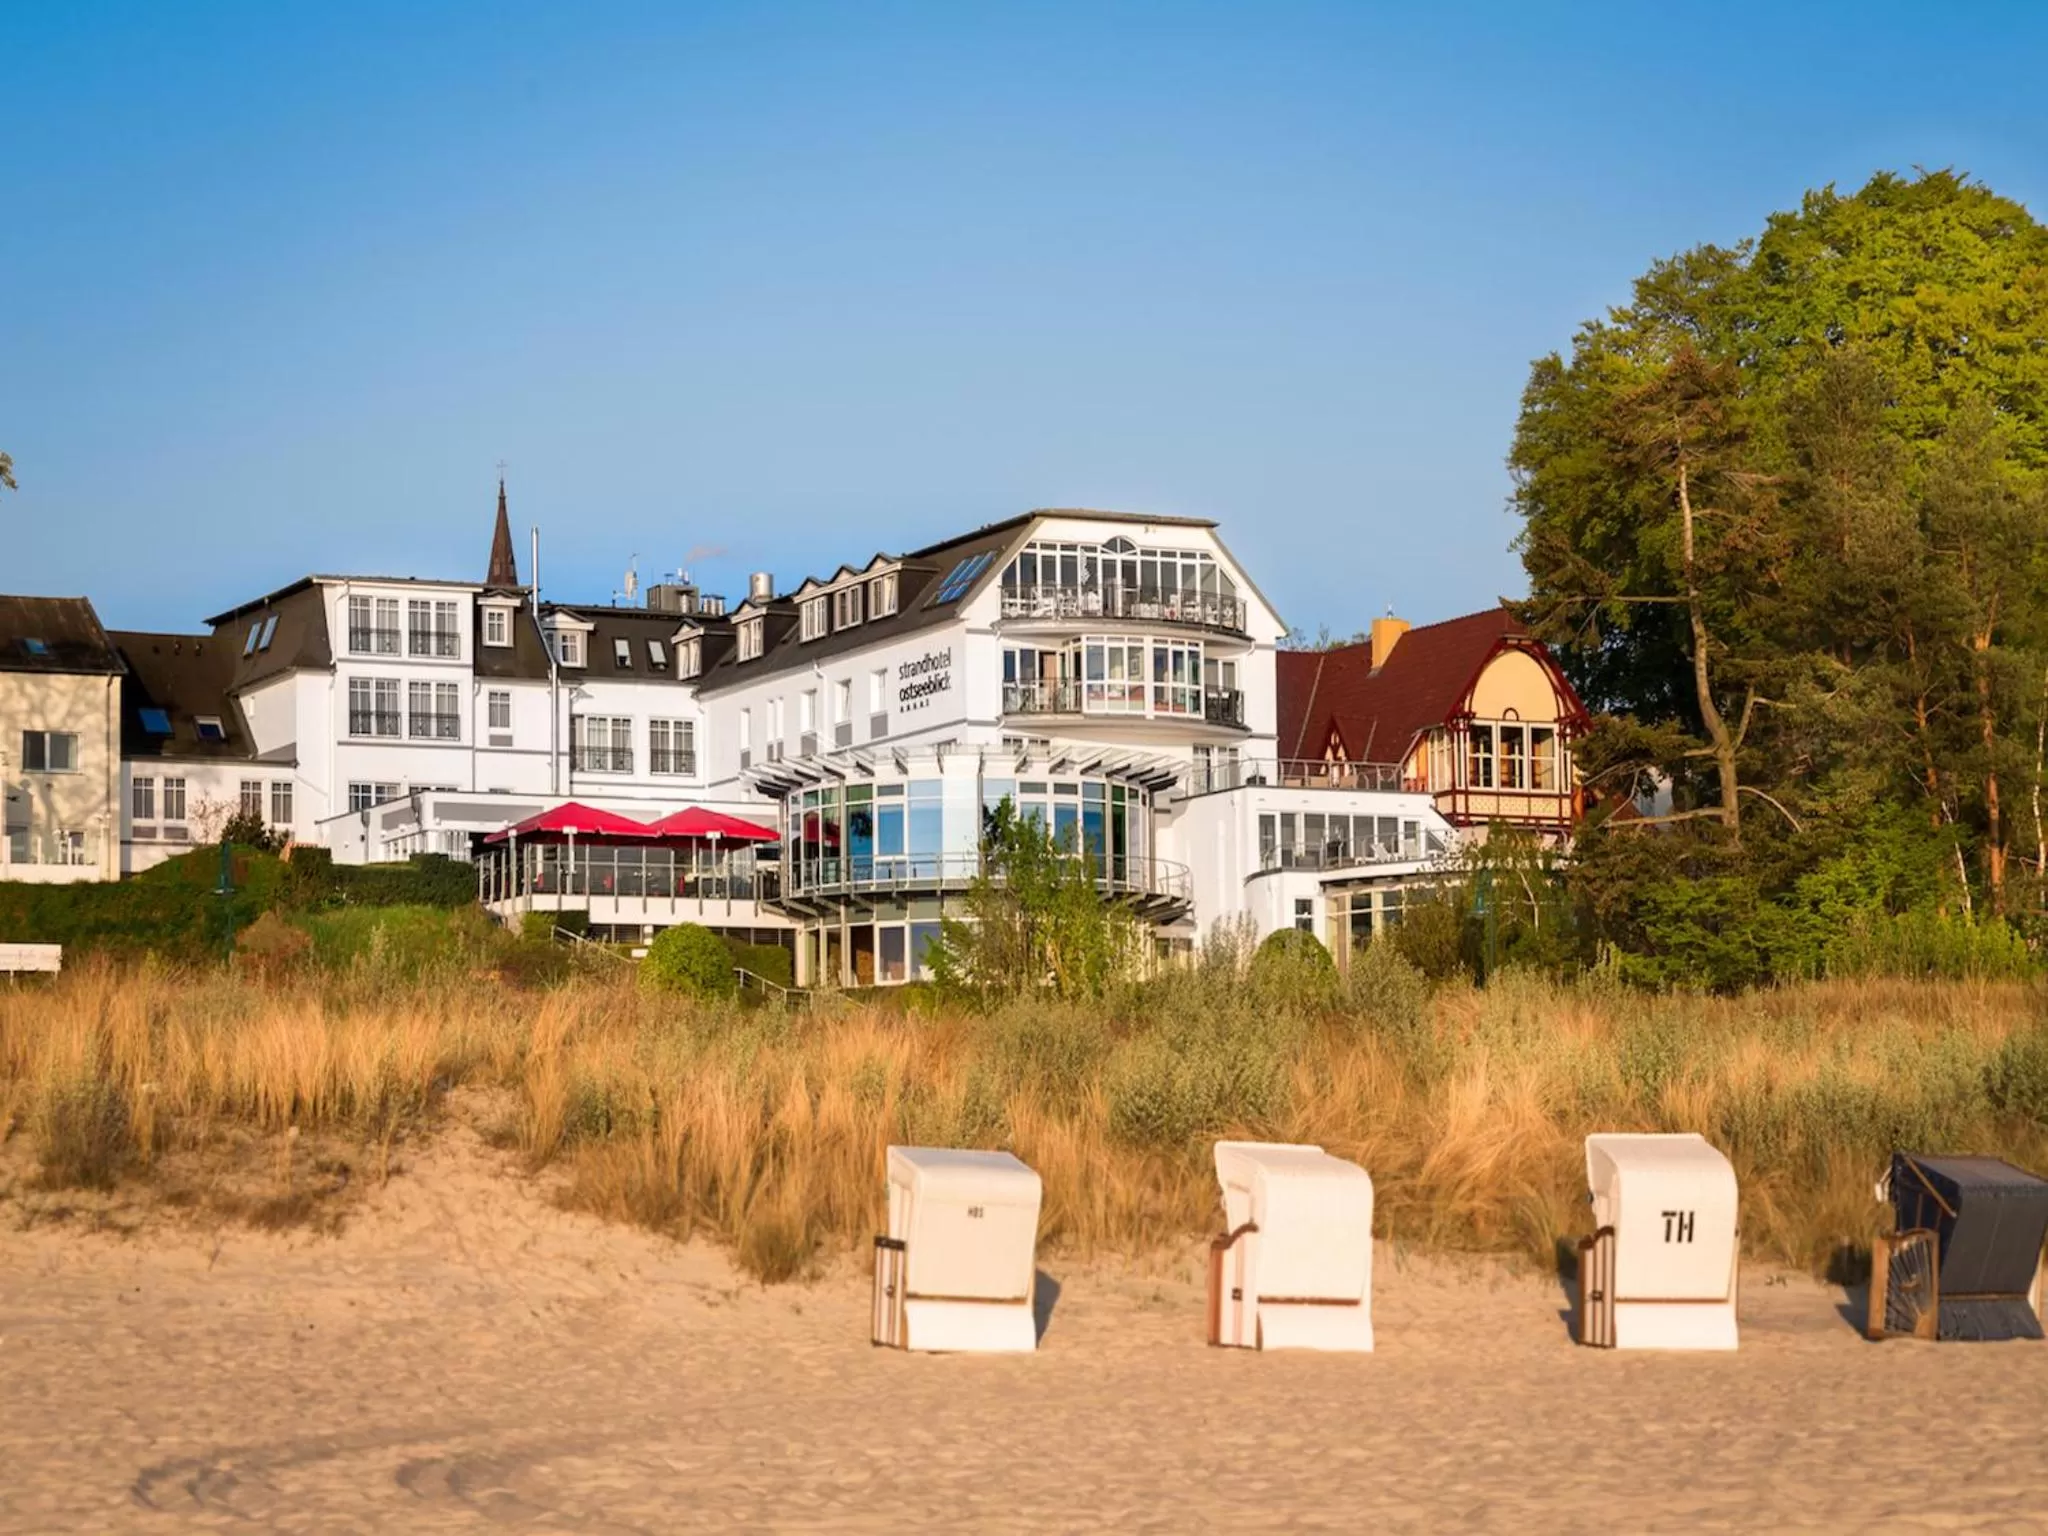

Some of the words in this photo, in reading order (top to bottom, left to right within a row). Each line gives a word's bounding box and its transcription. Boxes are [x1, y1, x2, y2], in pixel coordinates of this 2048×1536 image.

[899, 646, 951, 680] strandhotel
[899, 670, 951, 702] ostseeblick
[1661, 1210, 1694, 1243] TH
